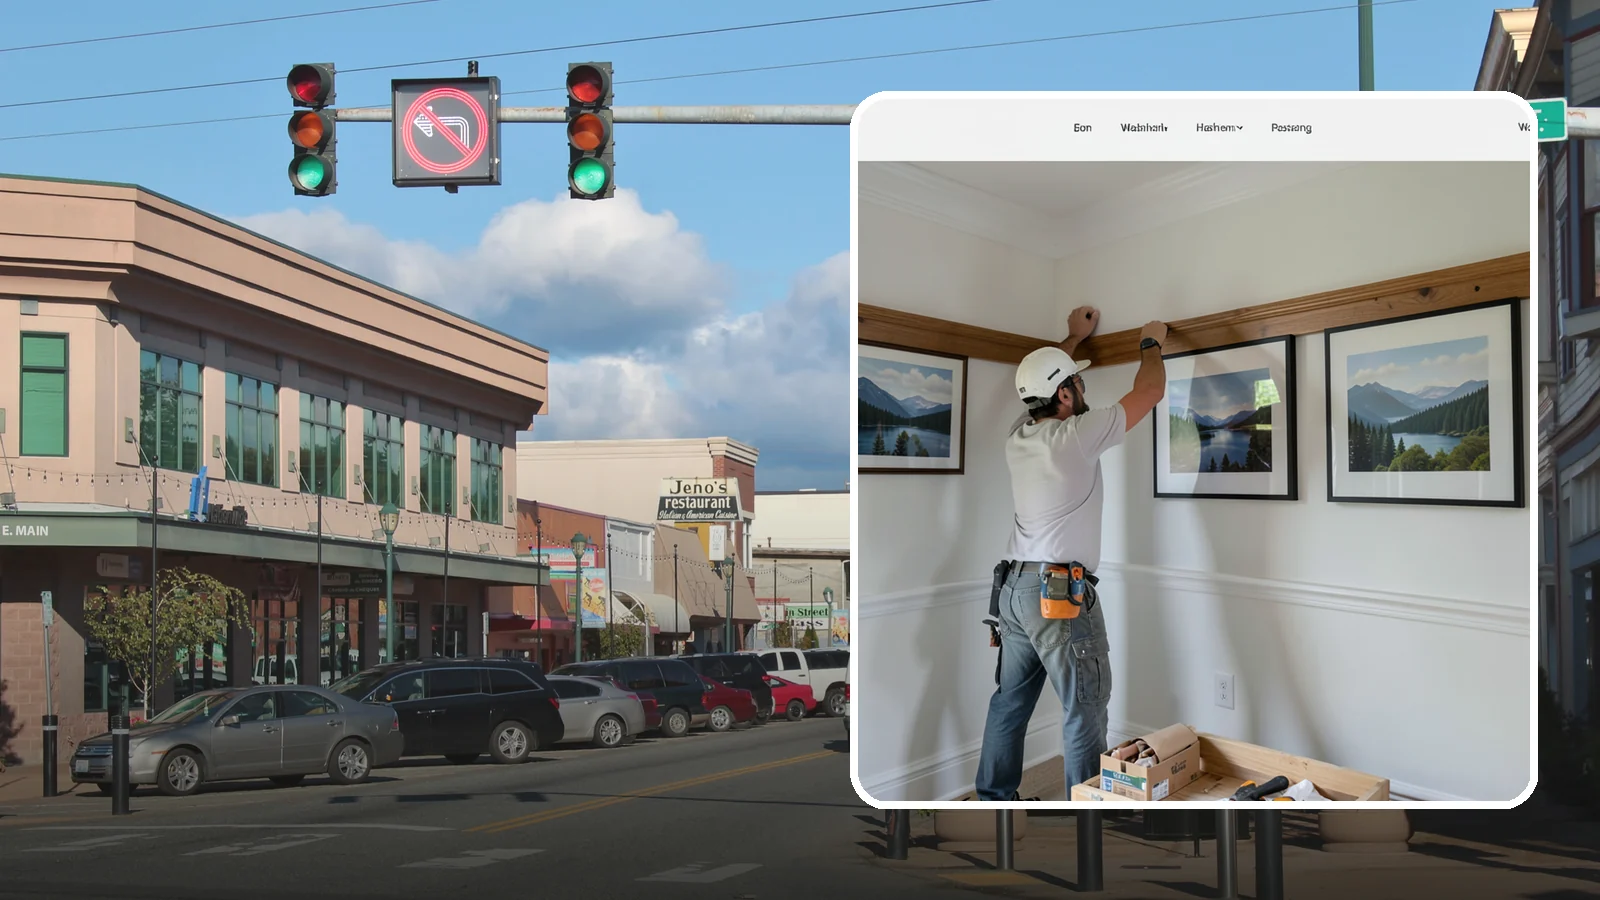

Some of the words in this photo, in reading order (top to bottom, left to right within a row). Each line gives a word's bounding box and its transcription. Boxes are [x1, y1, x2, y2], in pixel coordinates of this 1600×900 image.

[670, 480, 727, 494] Jeno's
[664, 496, 731, 509] restaurant
[686, 510, 714, 519] American
[715, 509, 737, 519] Cuisine
[2, 525, 13, 536] E.
[15, 525, 49, 536] MAIN
[797, 608, 828, 616] Street
[791, 619, 823, 627] lass
